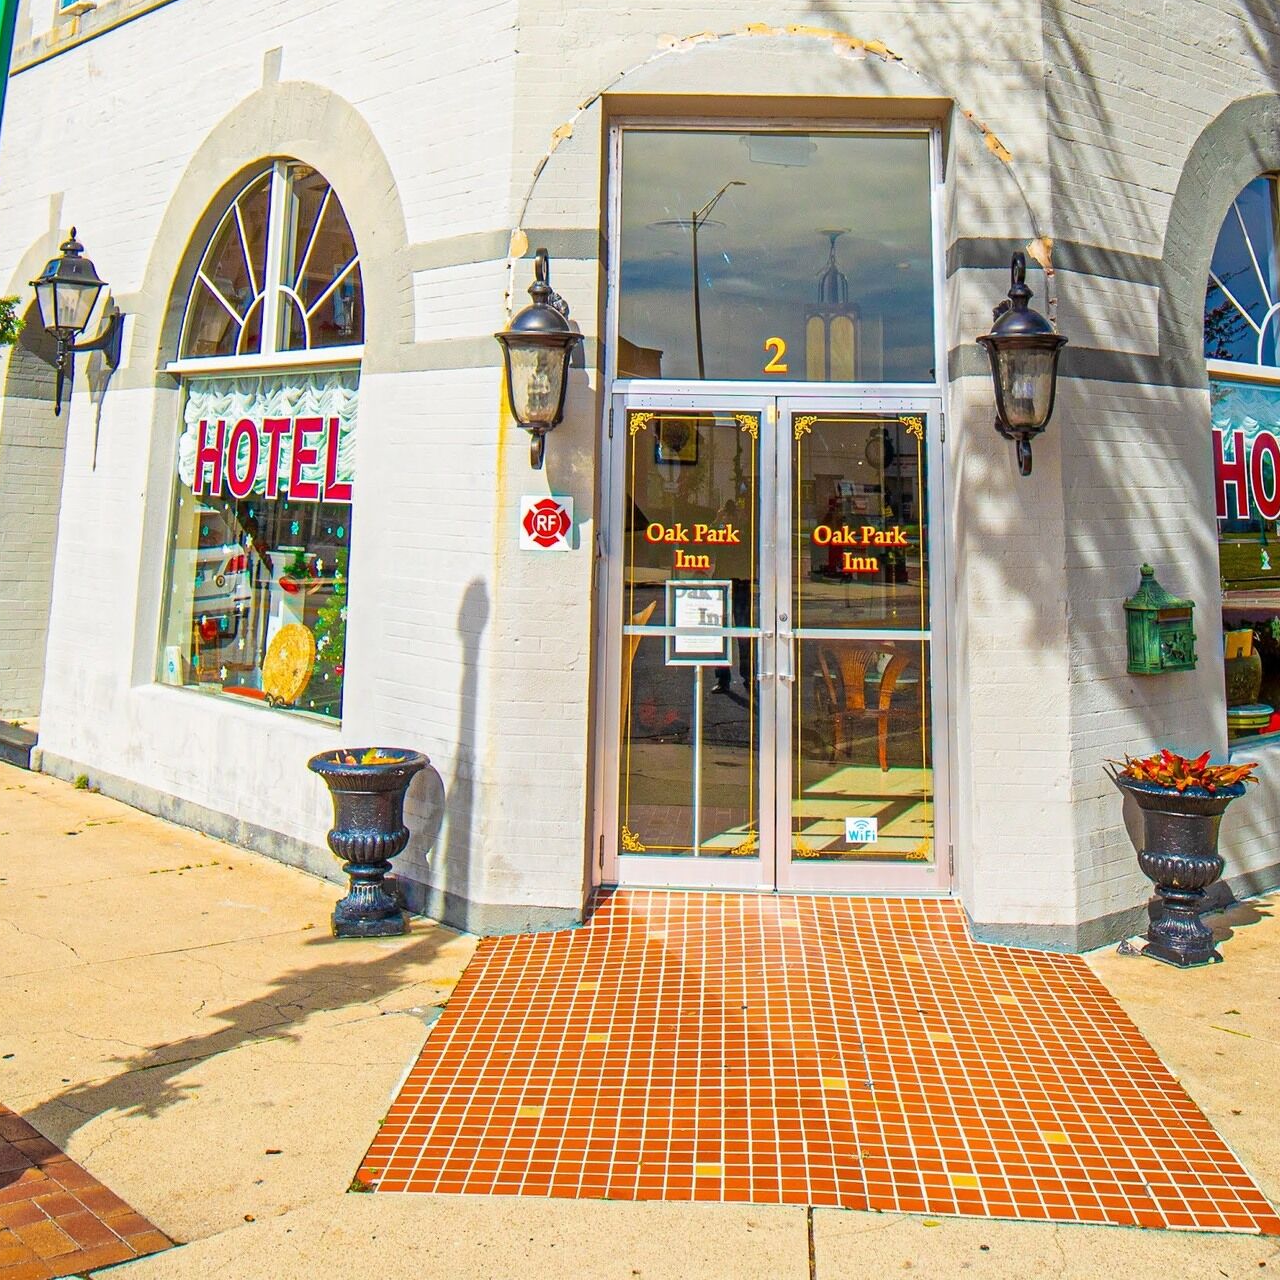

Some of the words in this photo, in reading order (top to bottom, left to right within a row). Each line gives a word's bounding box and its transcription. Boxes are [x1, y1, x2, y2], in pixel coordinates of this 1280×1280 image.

[763, 336, 788, 374] 2
[192, 415, 354, 504] HOTEL
[536, 514, 557, 532] RF
[644, 522, 690, 545] Oak
[692, 523, 741, 545] Park
[811, 525, 858, 547] Oak
[860, 525, 909, 547] Park
[674, 549, 713, 571] Inn
[841, 551, 880, 574] Inn
[848, 829, 876, 841] WiFi
